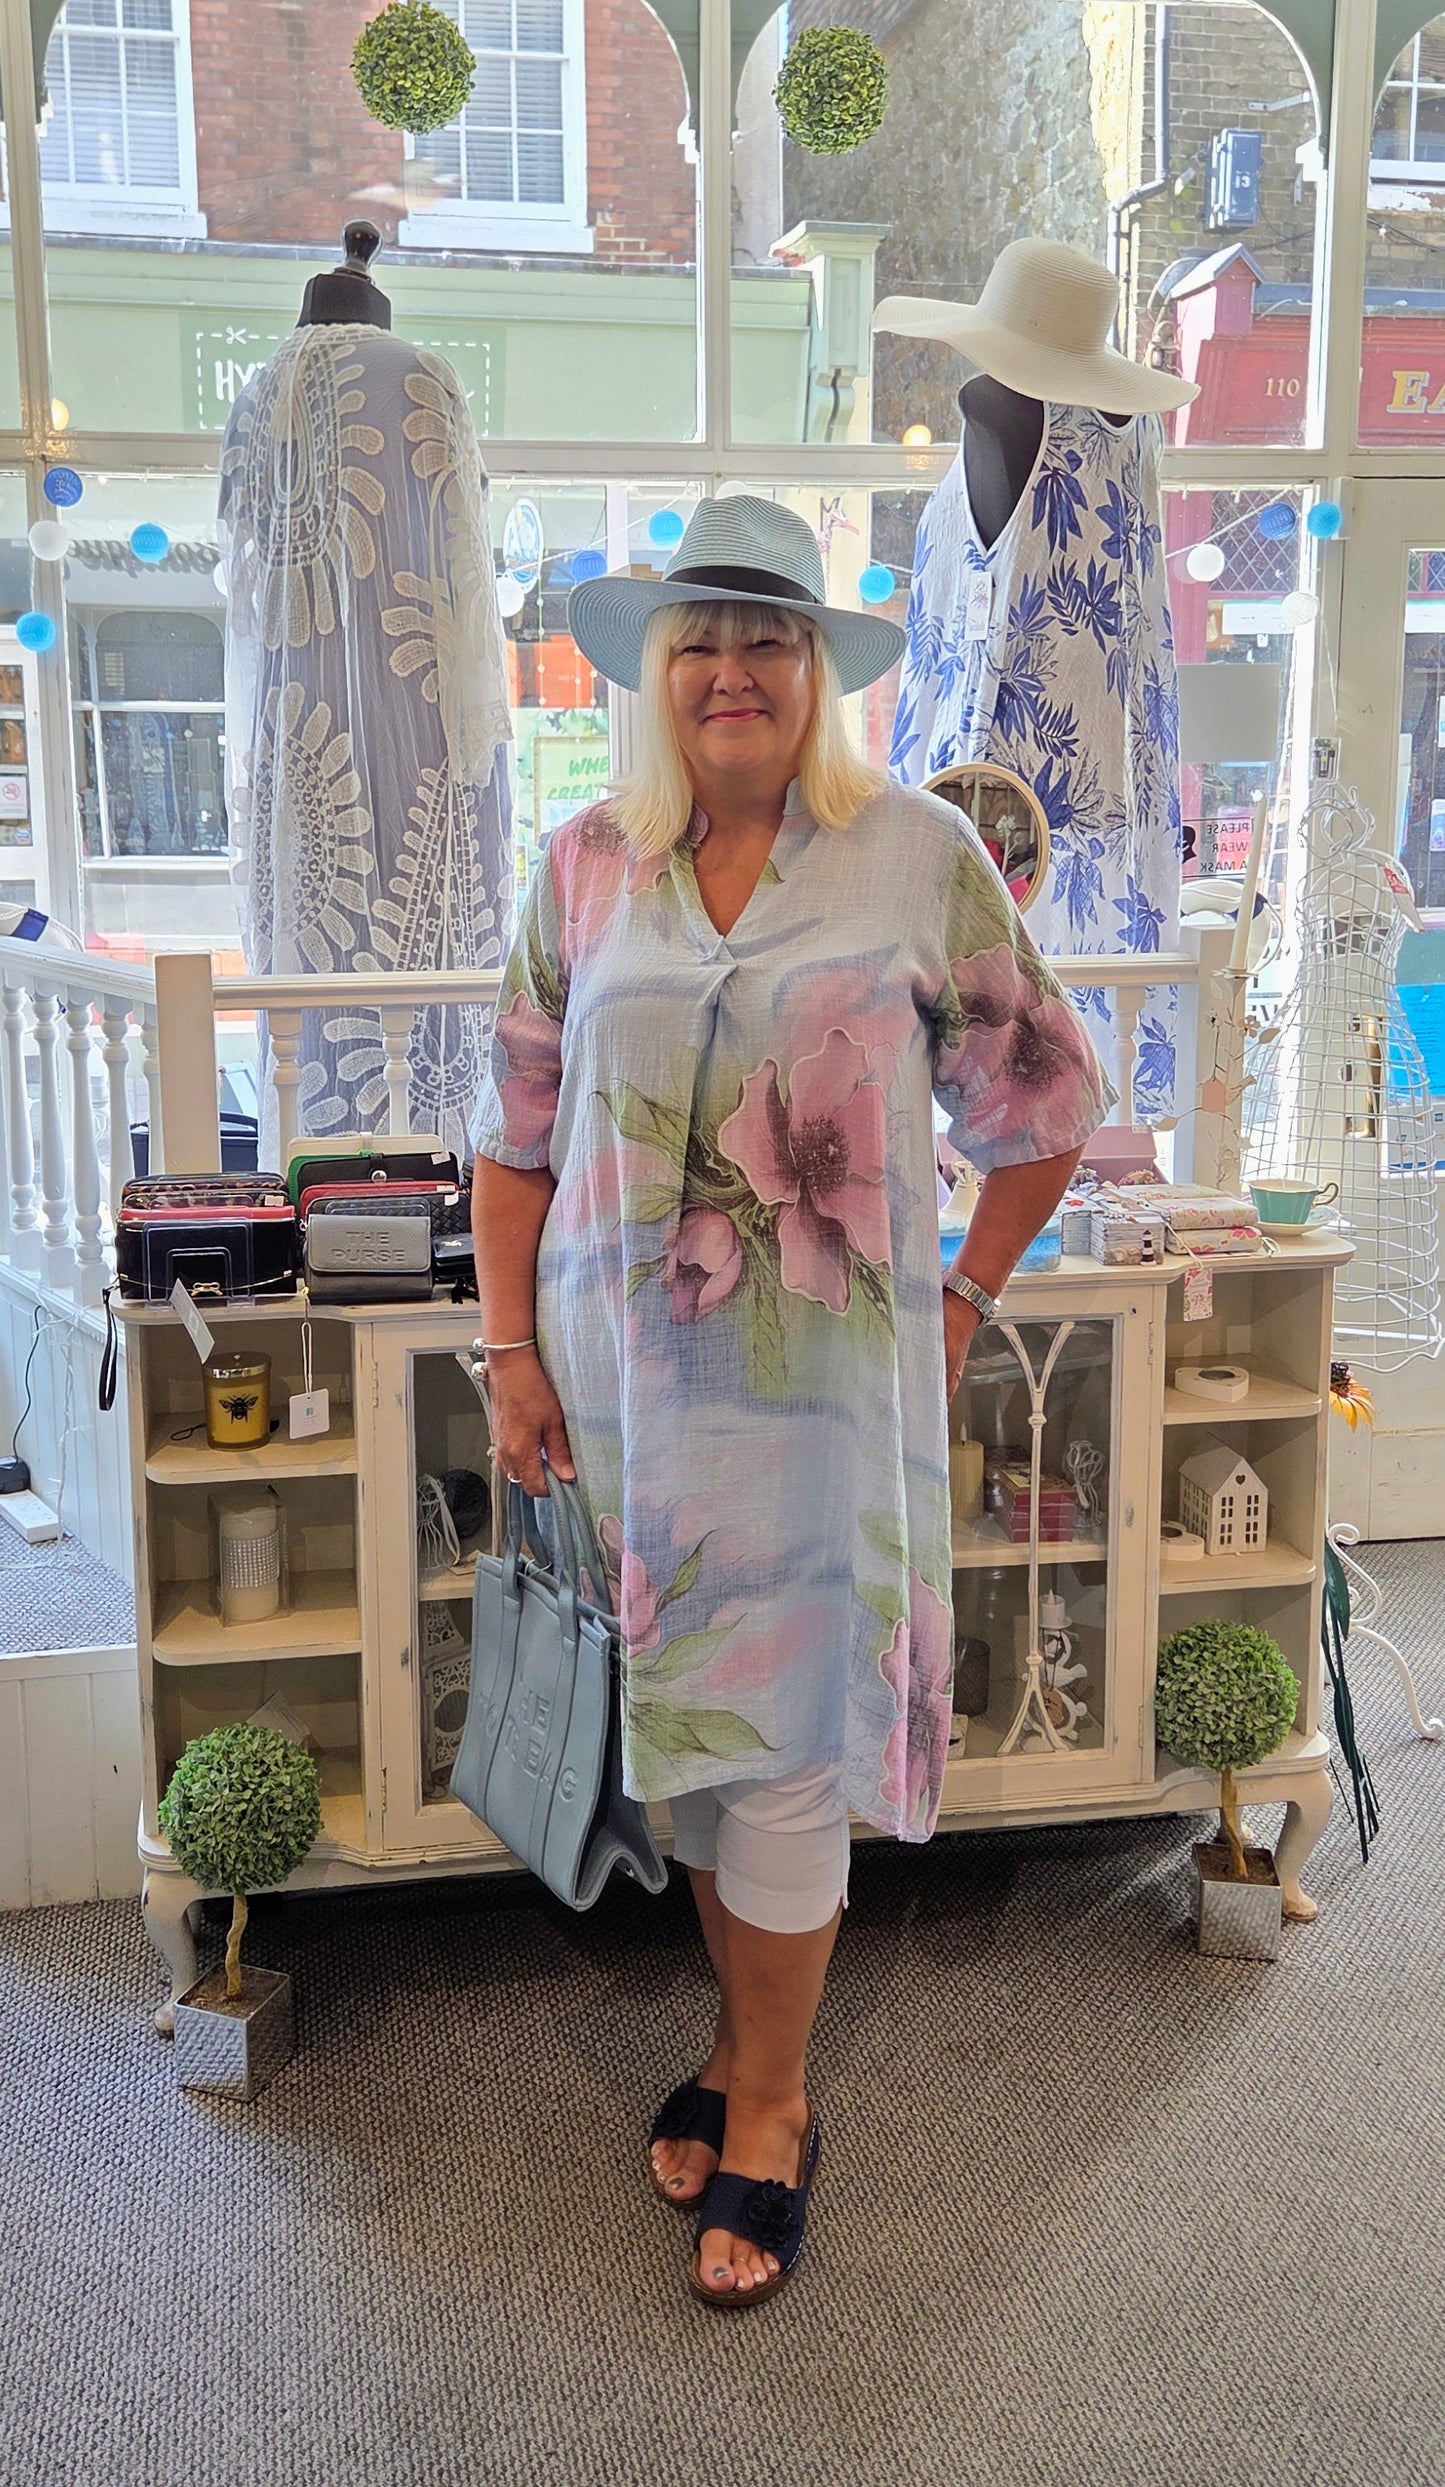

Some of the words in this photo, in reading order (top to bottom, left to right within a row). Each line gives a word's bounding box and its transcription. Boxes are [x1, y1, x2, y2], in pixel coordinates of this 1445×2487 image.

[1264, 377, 1300, 397] 110
[345, 1230, 391, 1247] THE
[331, 1248, 406, 1265] PURSE
